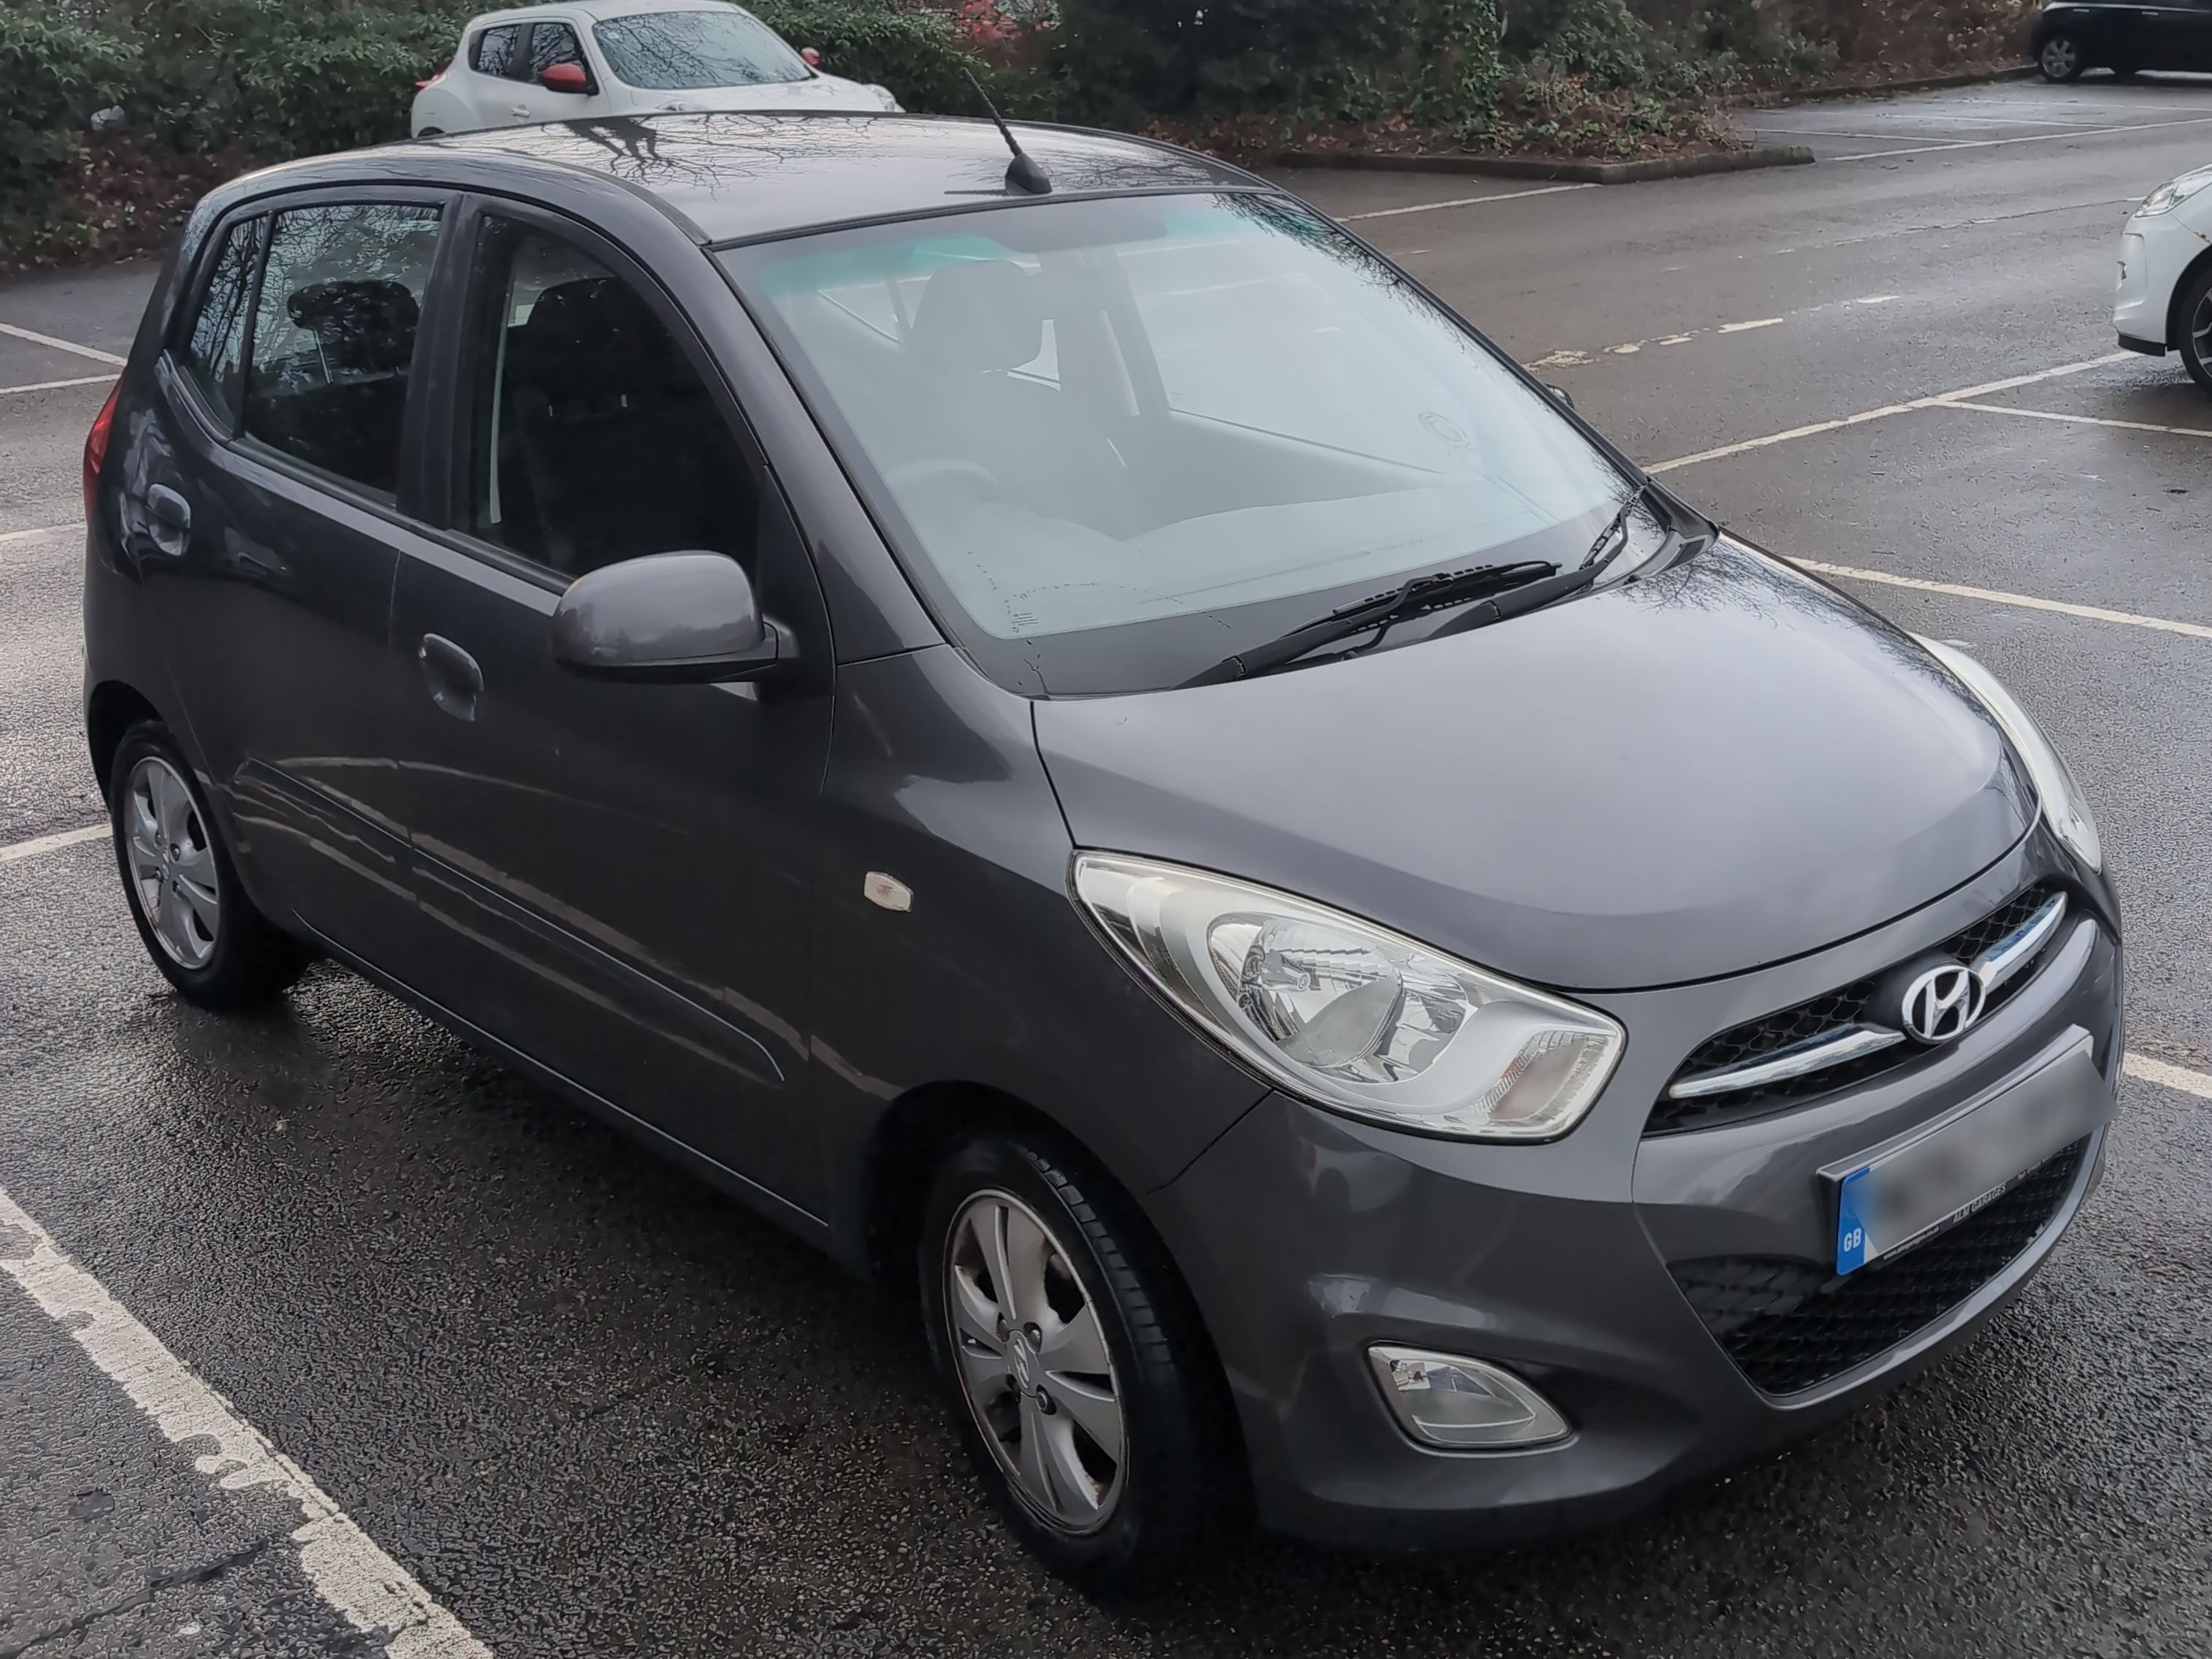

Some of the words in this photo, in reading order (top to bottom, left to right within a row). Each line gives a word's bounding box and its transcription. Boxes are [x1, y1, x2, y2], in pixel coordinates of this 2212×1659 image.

[1952, 1205, 1970, 1224] ALM
[1971, 1183, 2006, 1213] GARAGES
[1843, 1227, 1862, 1252] GB
